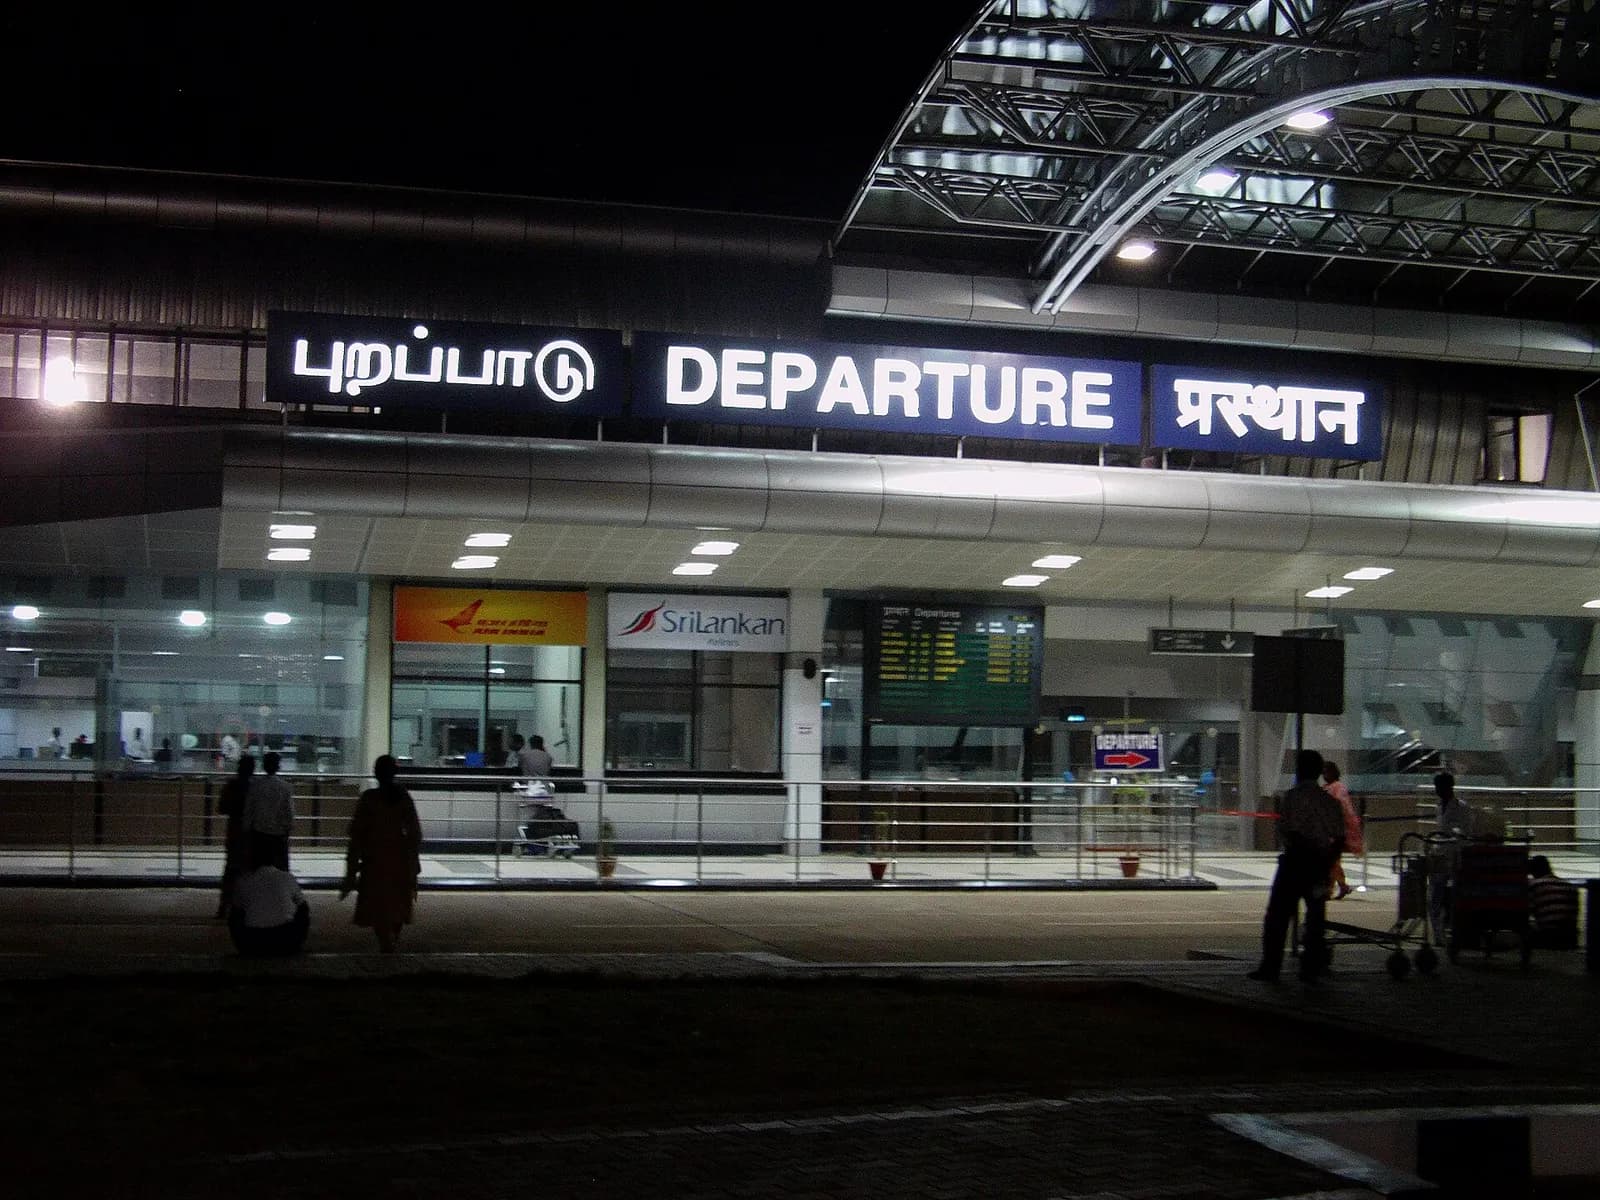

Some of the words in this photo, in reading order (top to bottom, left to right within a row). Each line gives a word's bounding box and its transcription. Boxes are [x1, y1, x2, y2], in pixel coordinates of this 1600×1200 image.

[293, 325, 596, 403] புறப்பாடு
[665, 345, 1114, 430] DEPARTURE
[1172, 378, 1366, 446] प्रस्थान
[662, 609, 785, 636] SriLankan
[1096, 734, 1158, 750] DEPARTURE
